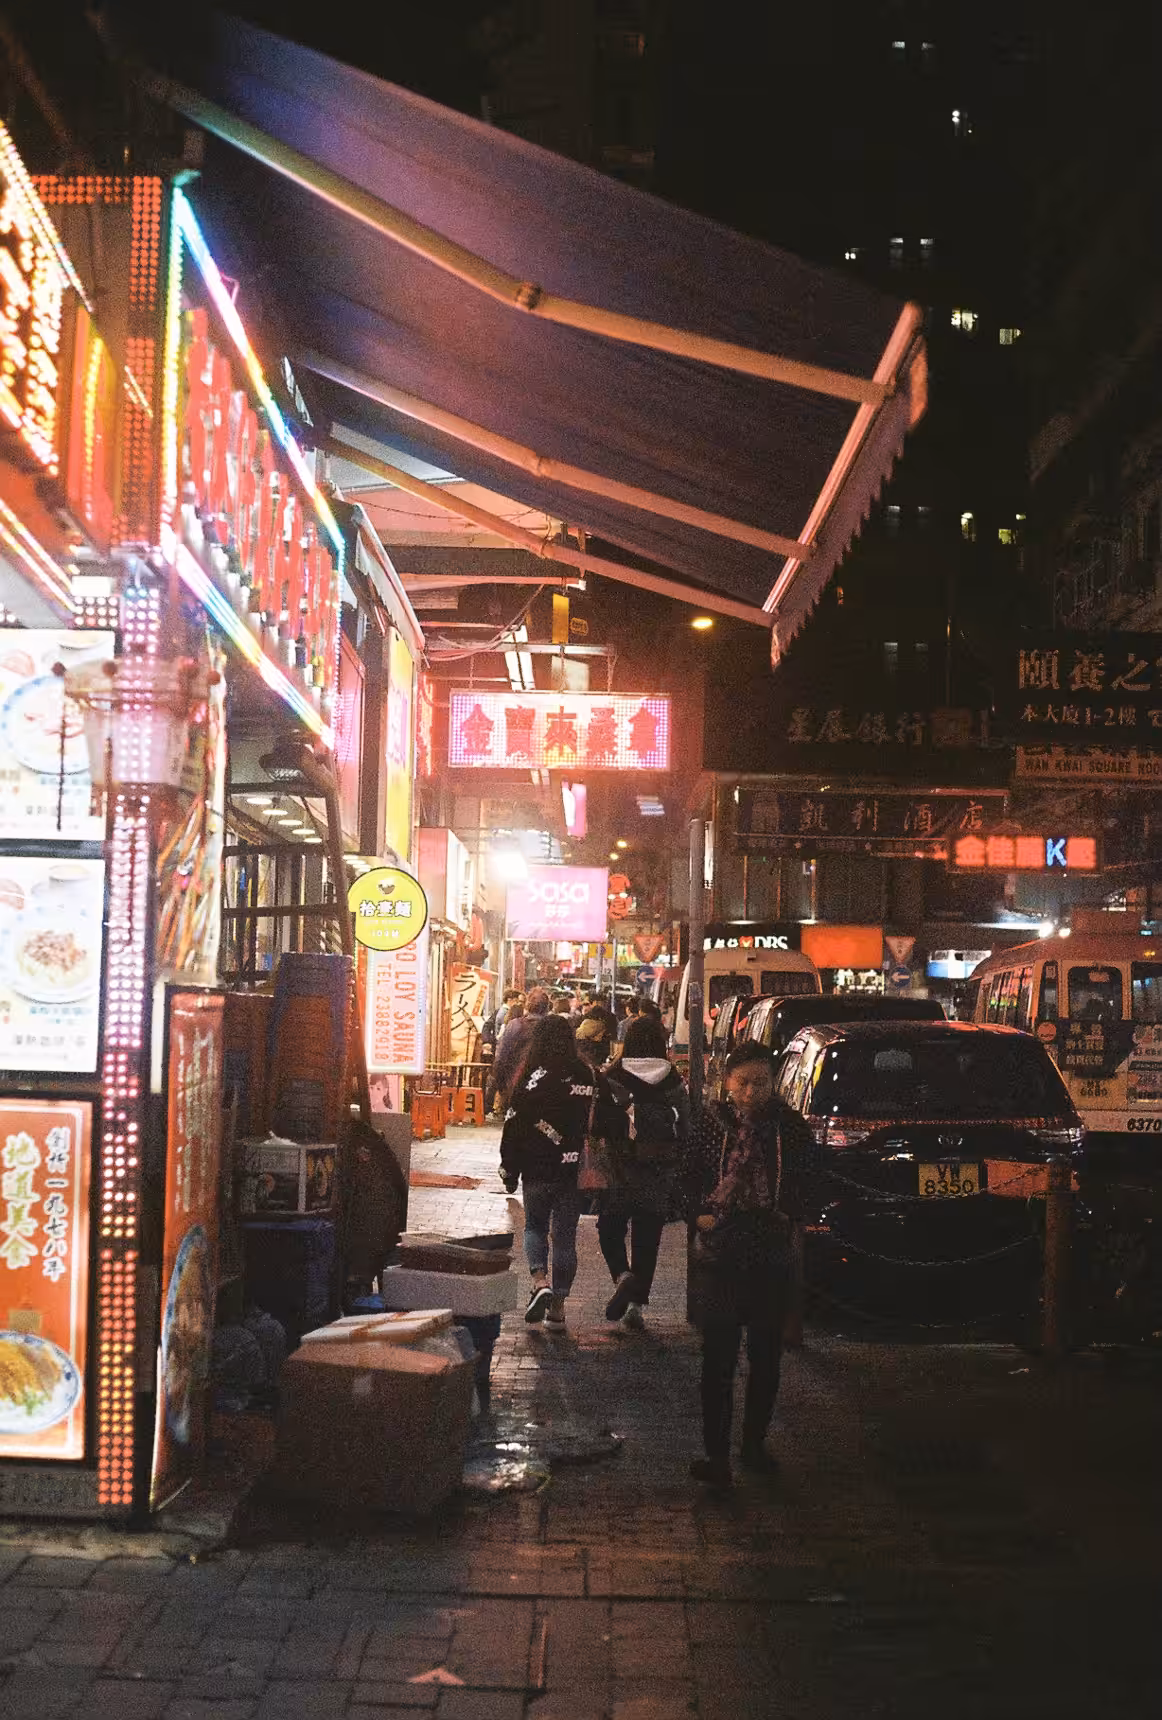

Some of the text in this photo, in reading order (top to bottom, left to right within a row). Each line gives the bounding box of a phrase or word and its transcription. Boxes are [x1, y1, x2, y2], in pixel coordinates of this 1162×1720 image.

[1017, 648, 1162, 691] 頤養之
[394, 970, 416, 1001] LOY
[392, 1010, 415, 1062] SAUNA
[2, 1131, 41, 1270] 地道美食
[924, 1180, 973, 1194] 8350
